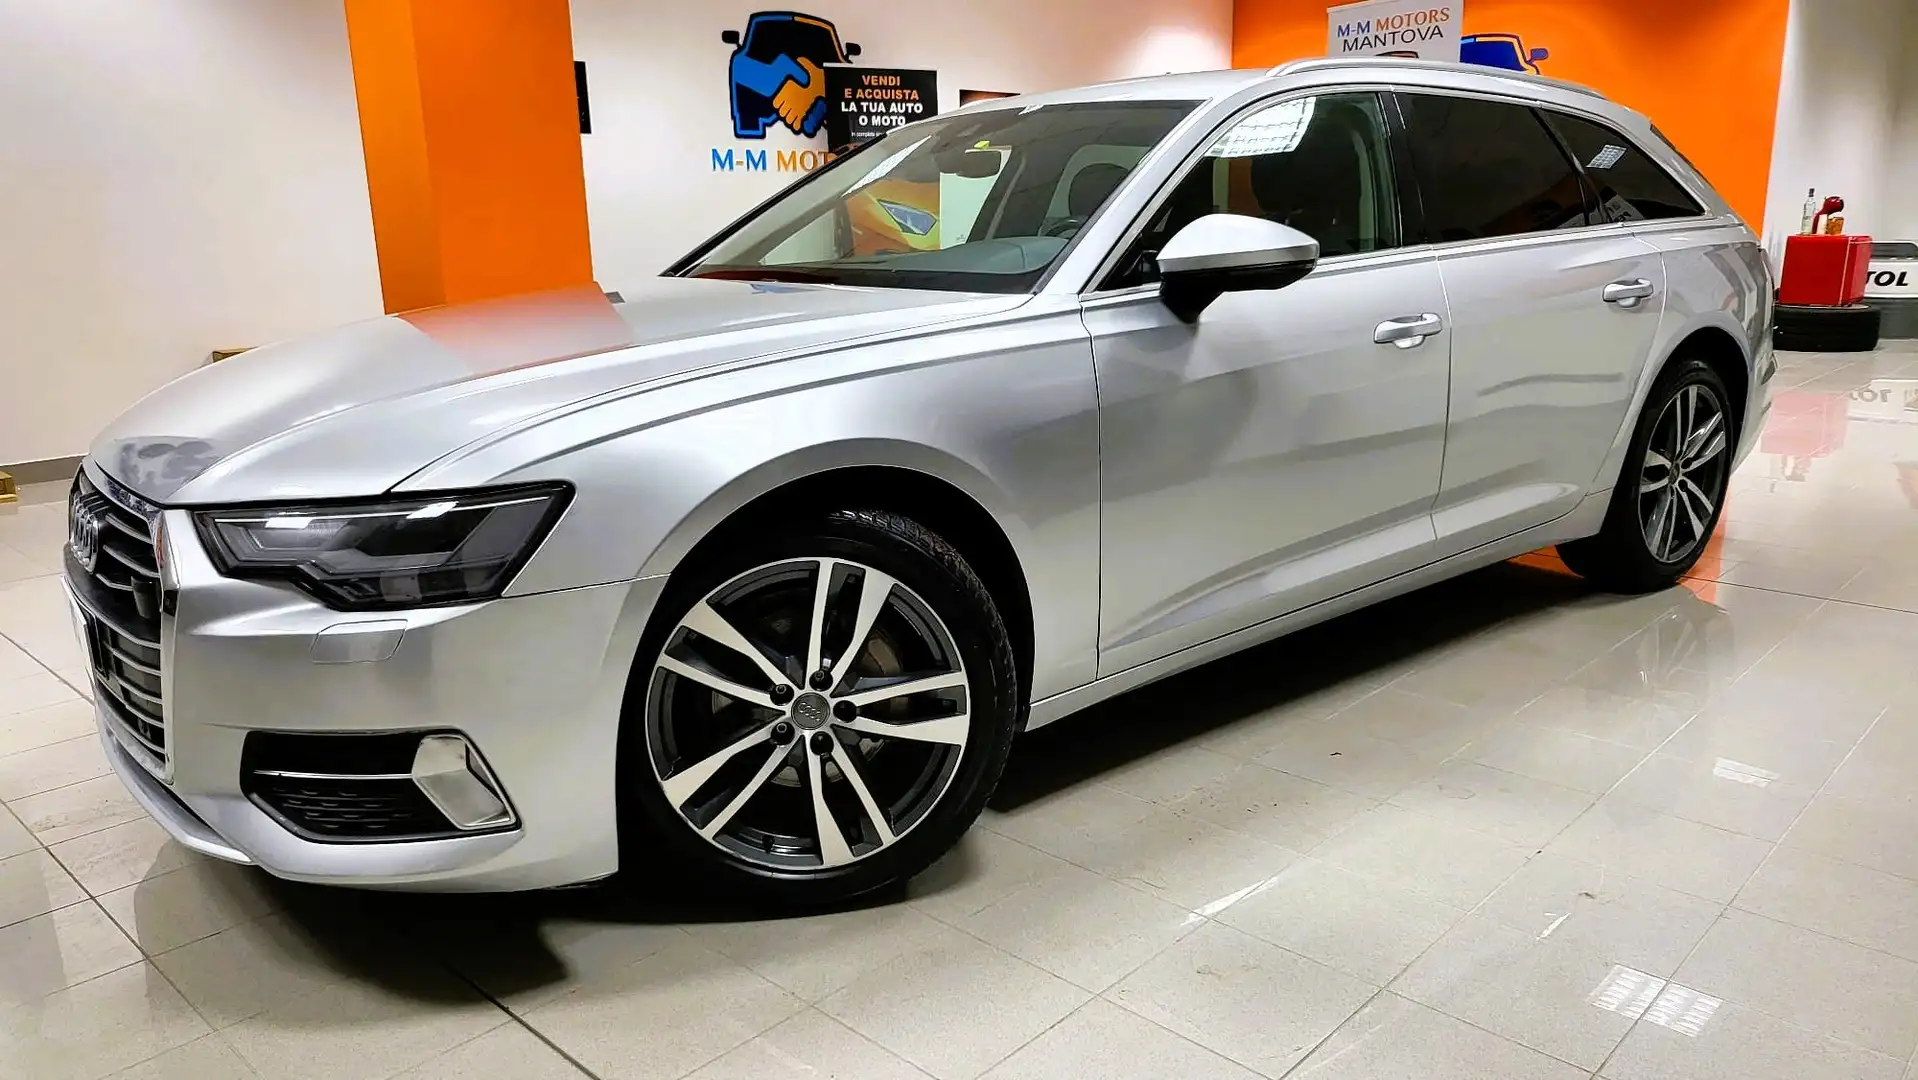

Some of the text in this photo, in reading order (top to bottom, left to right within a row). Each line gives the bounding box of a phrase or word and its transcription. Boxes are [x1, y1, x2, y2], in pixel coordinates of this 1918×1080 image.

[1337, 7, 1450, 38] M-M MOTORS
[1342, 25, 1444, 52] MANTOVA
[861, 74, 901, 86] VENDI
[844, 88, 920, 100] E ACQUISTA
[841, 101, 924, 114] LA TUA AUTO
[858, 115, 906, 126] O MOTO
[711, 149, 767, 172] M-M
